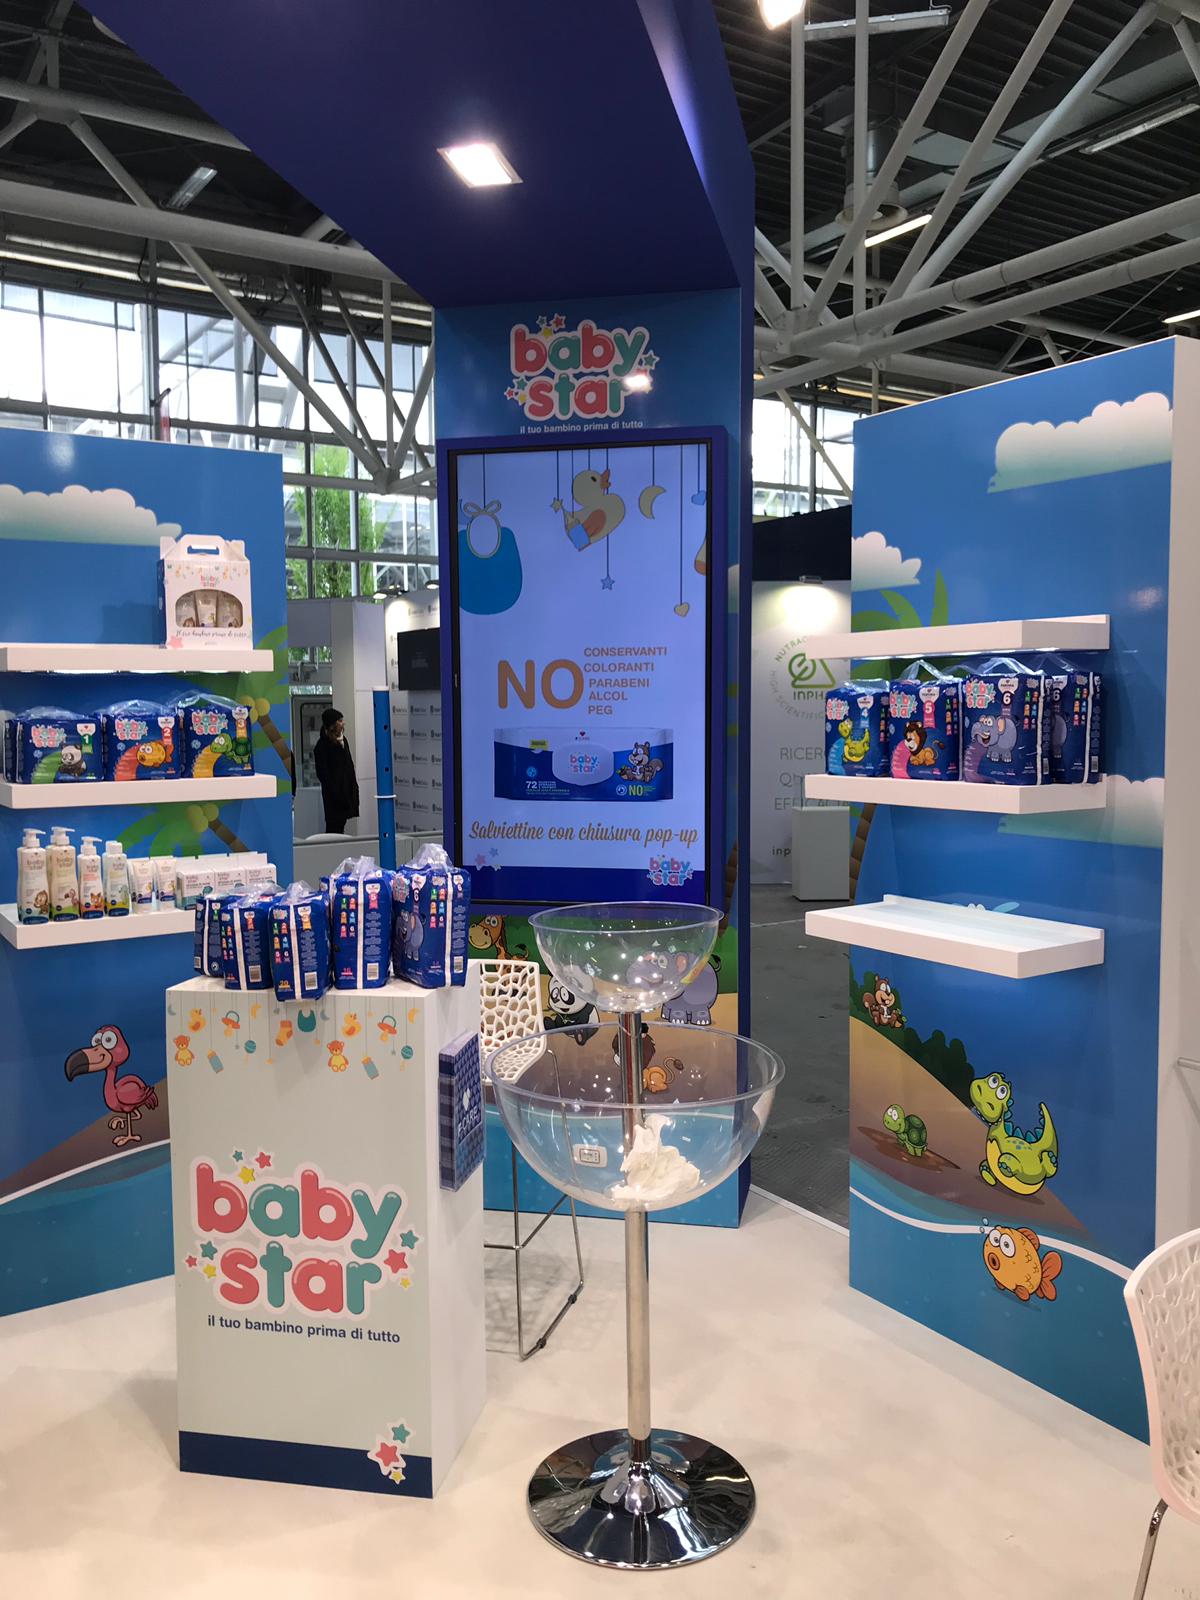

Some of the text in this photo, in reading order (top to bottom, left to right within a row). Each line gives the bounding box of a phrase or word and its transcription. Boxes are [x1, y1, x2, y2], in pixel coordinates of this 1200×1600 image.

[514, 322, 646, 376] baby
[528, 372, 626, 417] star
[519, 420, 643, 435] il tuo bambino prima di tutto
[584, 647, 667, 657] CONSERVANTI
[584, 662, 654, 672] COLORANTI
[498, 659, 584, 709] NO
[589, 678, 650, 688] PARABENI
[965, 681, 994, 696] baby
[589, 691, 628, 701] ALCOL
[793, 691, 826, 701] INPH
[889, 692, 916, 706] baby
[967, 694, 990, 708] star
[1003, 693, 1011, 705] 6
[1053, 690, 1060, 701] 6
[588, 705, 613, 715] PEG
[891, 706, 912, 718] star
[925, 702, 933, 714] 5
[192, 711, 227, 724] baby
[115, 719, 146, 731] baby
[195, 723, 221, 735] star
[32, 726, 64, 738] baby
[118, 730, 141, 740] star
[164, 728, 171, 737] 2
[83, 735, 89, 744] 1
[570, 754, 598, 765] baby
[780, 747, 825, 760] RICER
[573, 764, 596, 773] star
[526, 781, 538, 789] 72
[629, 785, 644, 796] NO
[469, 820, 699, 848] Salviettine con chiusura pop-up
[772, 847, 792, 856] inp
[650, 858, 691, 872] baby
[652, 871, 685, 886] star
[413, 889, 419, 901] 6
[196, 1162, 402, 1259] baby
[220, 1240, 383, 1315] star
[207, 1315, 401, 1343] il tuo bambino prima di tutto
